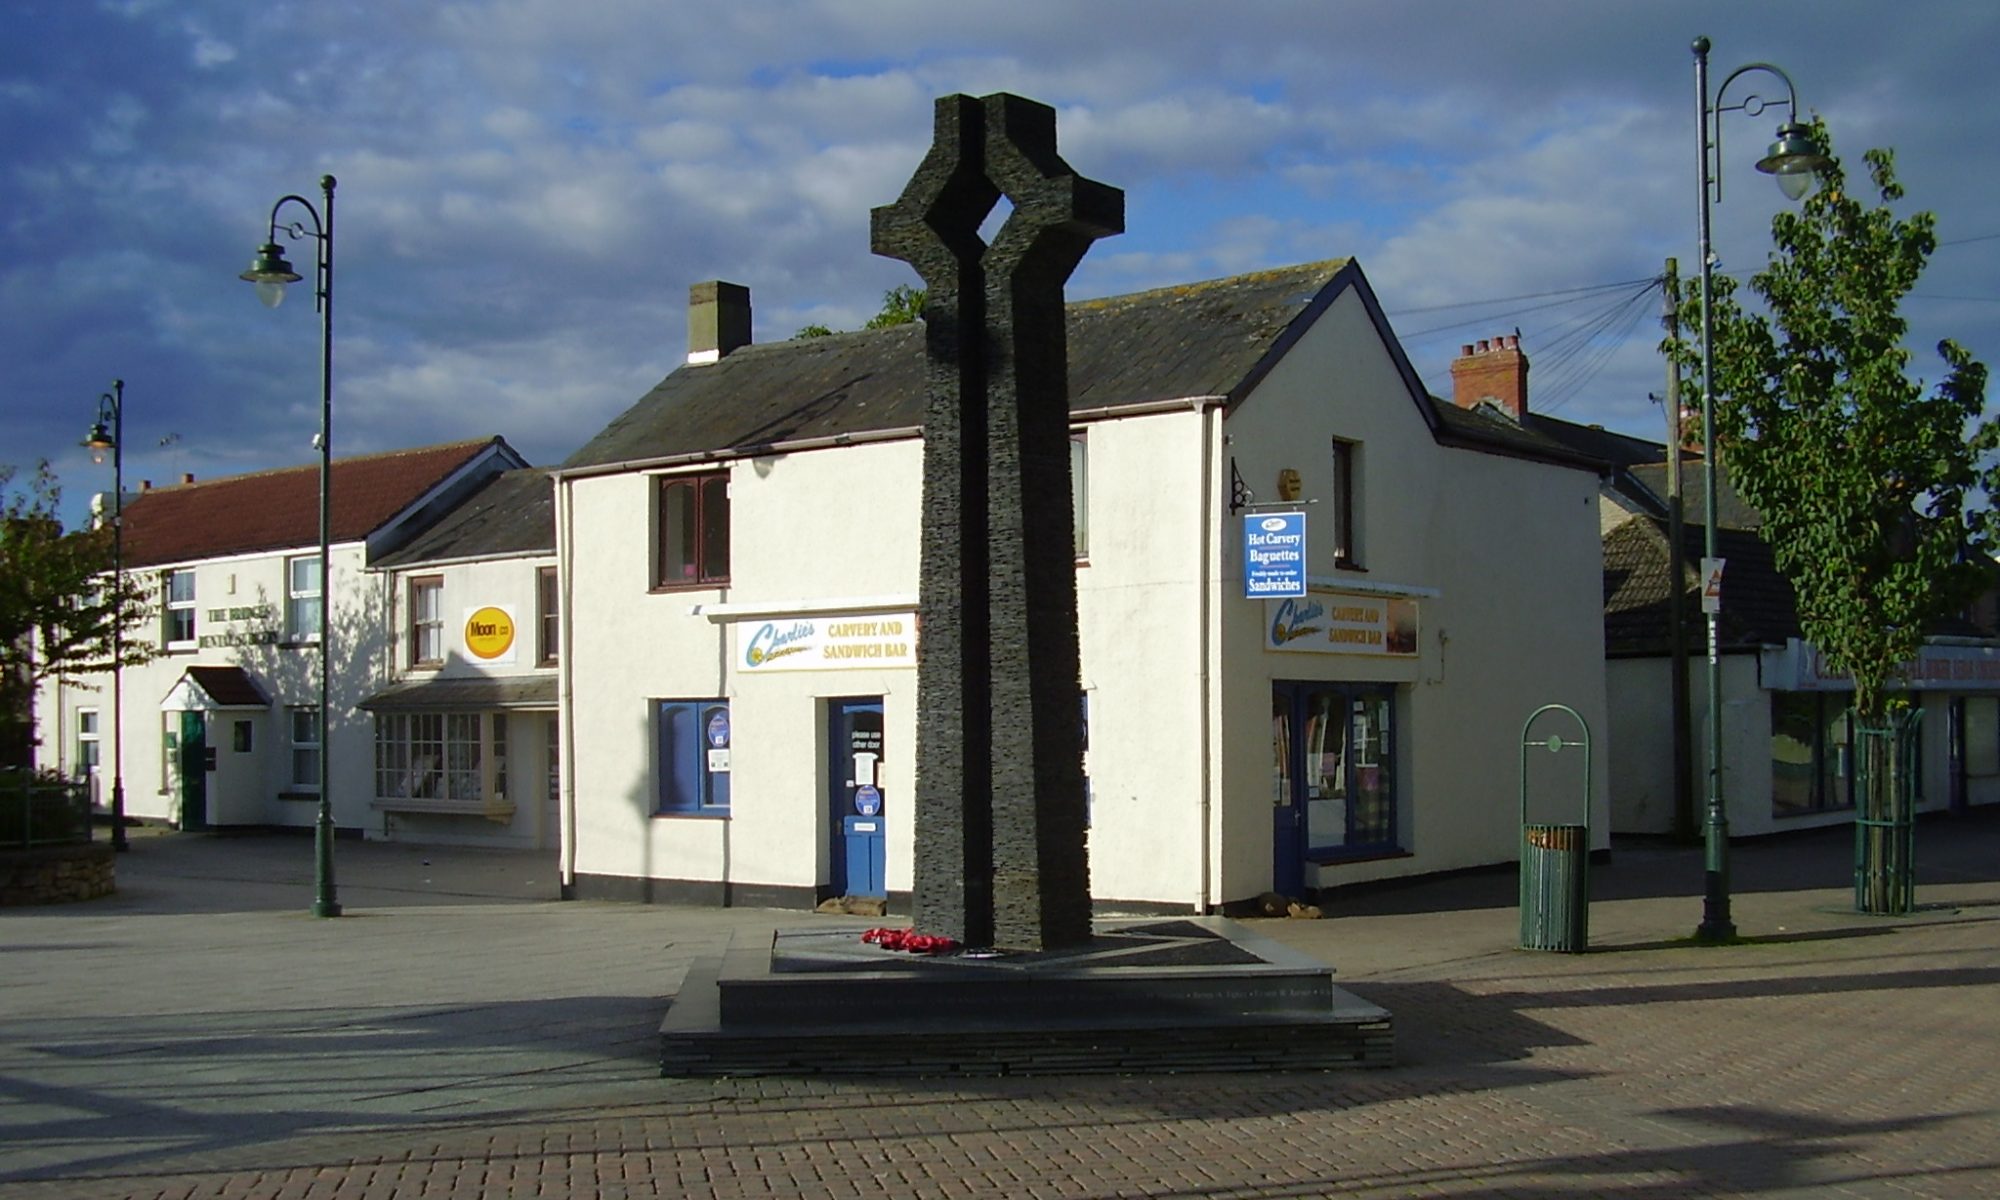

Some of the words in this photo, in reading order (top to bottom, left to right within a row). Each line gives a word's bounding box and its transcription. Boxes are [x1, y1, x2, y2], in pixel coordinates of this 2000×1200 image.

[1248, 533, 1265, 546] Hot
[1266, 532, 1301, 547] Carvery
[1249, 549, 1300, 566] Baguettes
[1248, 577, 1301, 592] Sandwiches
[208, 608, 226, 622] THE
[1332, 606, 1364, 623] CARVERY
[1364, 607, 1380, 624] AND
[470, 621, 496, 637] Moon
[827, 622, 877, 638] CARVERY
[880, 621, 902, 636] AND
[1328, 627, 1367, 644] SANDWICH
[1368, 629, 1382, 645] BAR
[746, 620, 815, 667] Charlie's
[823, 643, 882, 659] SANDWICH
[885, 642, 908, 657] BAR
[851, 731, 870, 740] please
[870, 731, 881, 739] use
[852, 740, 866, 749] other
[867, 740, 880, 749] door
